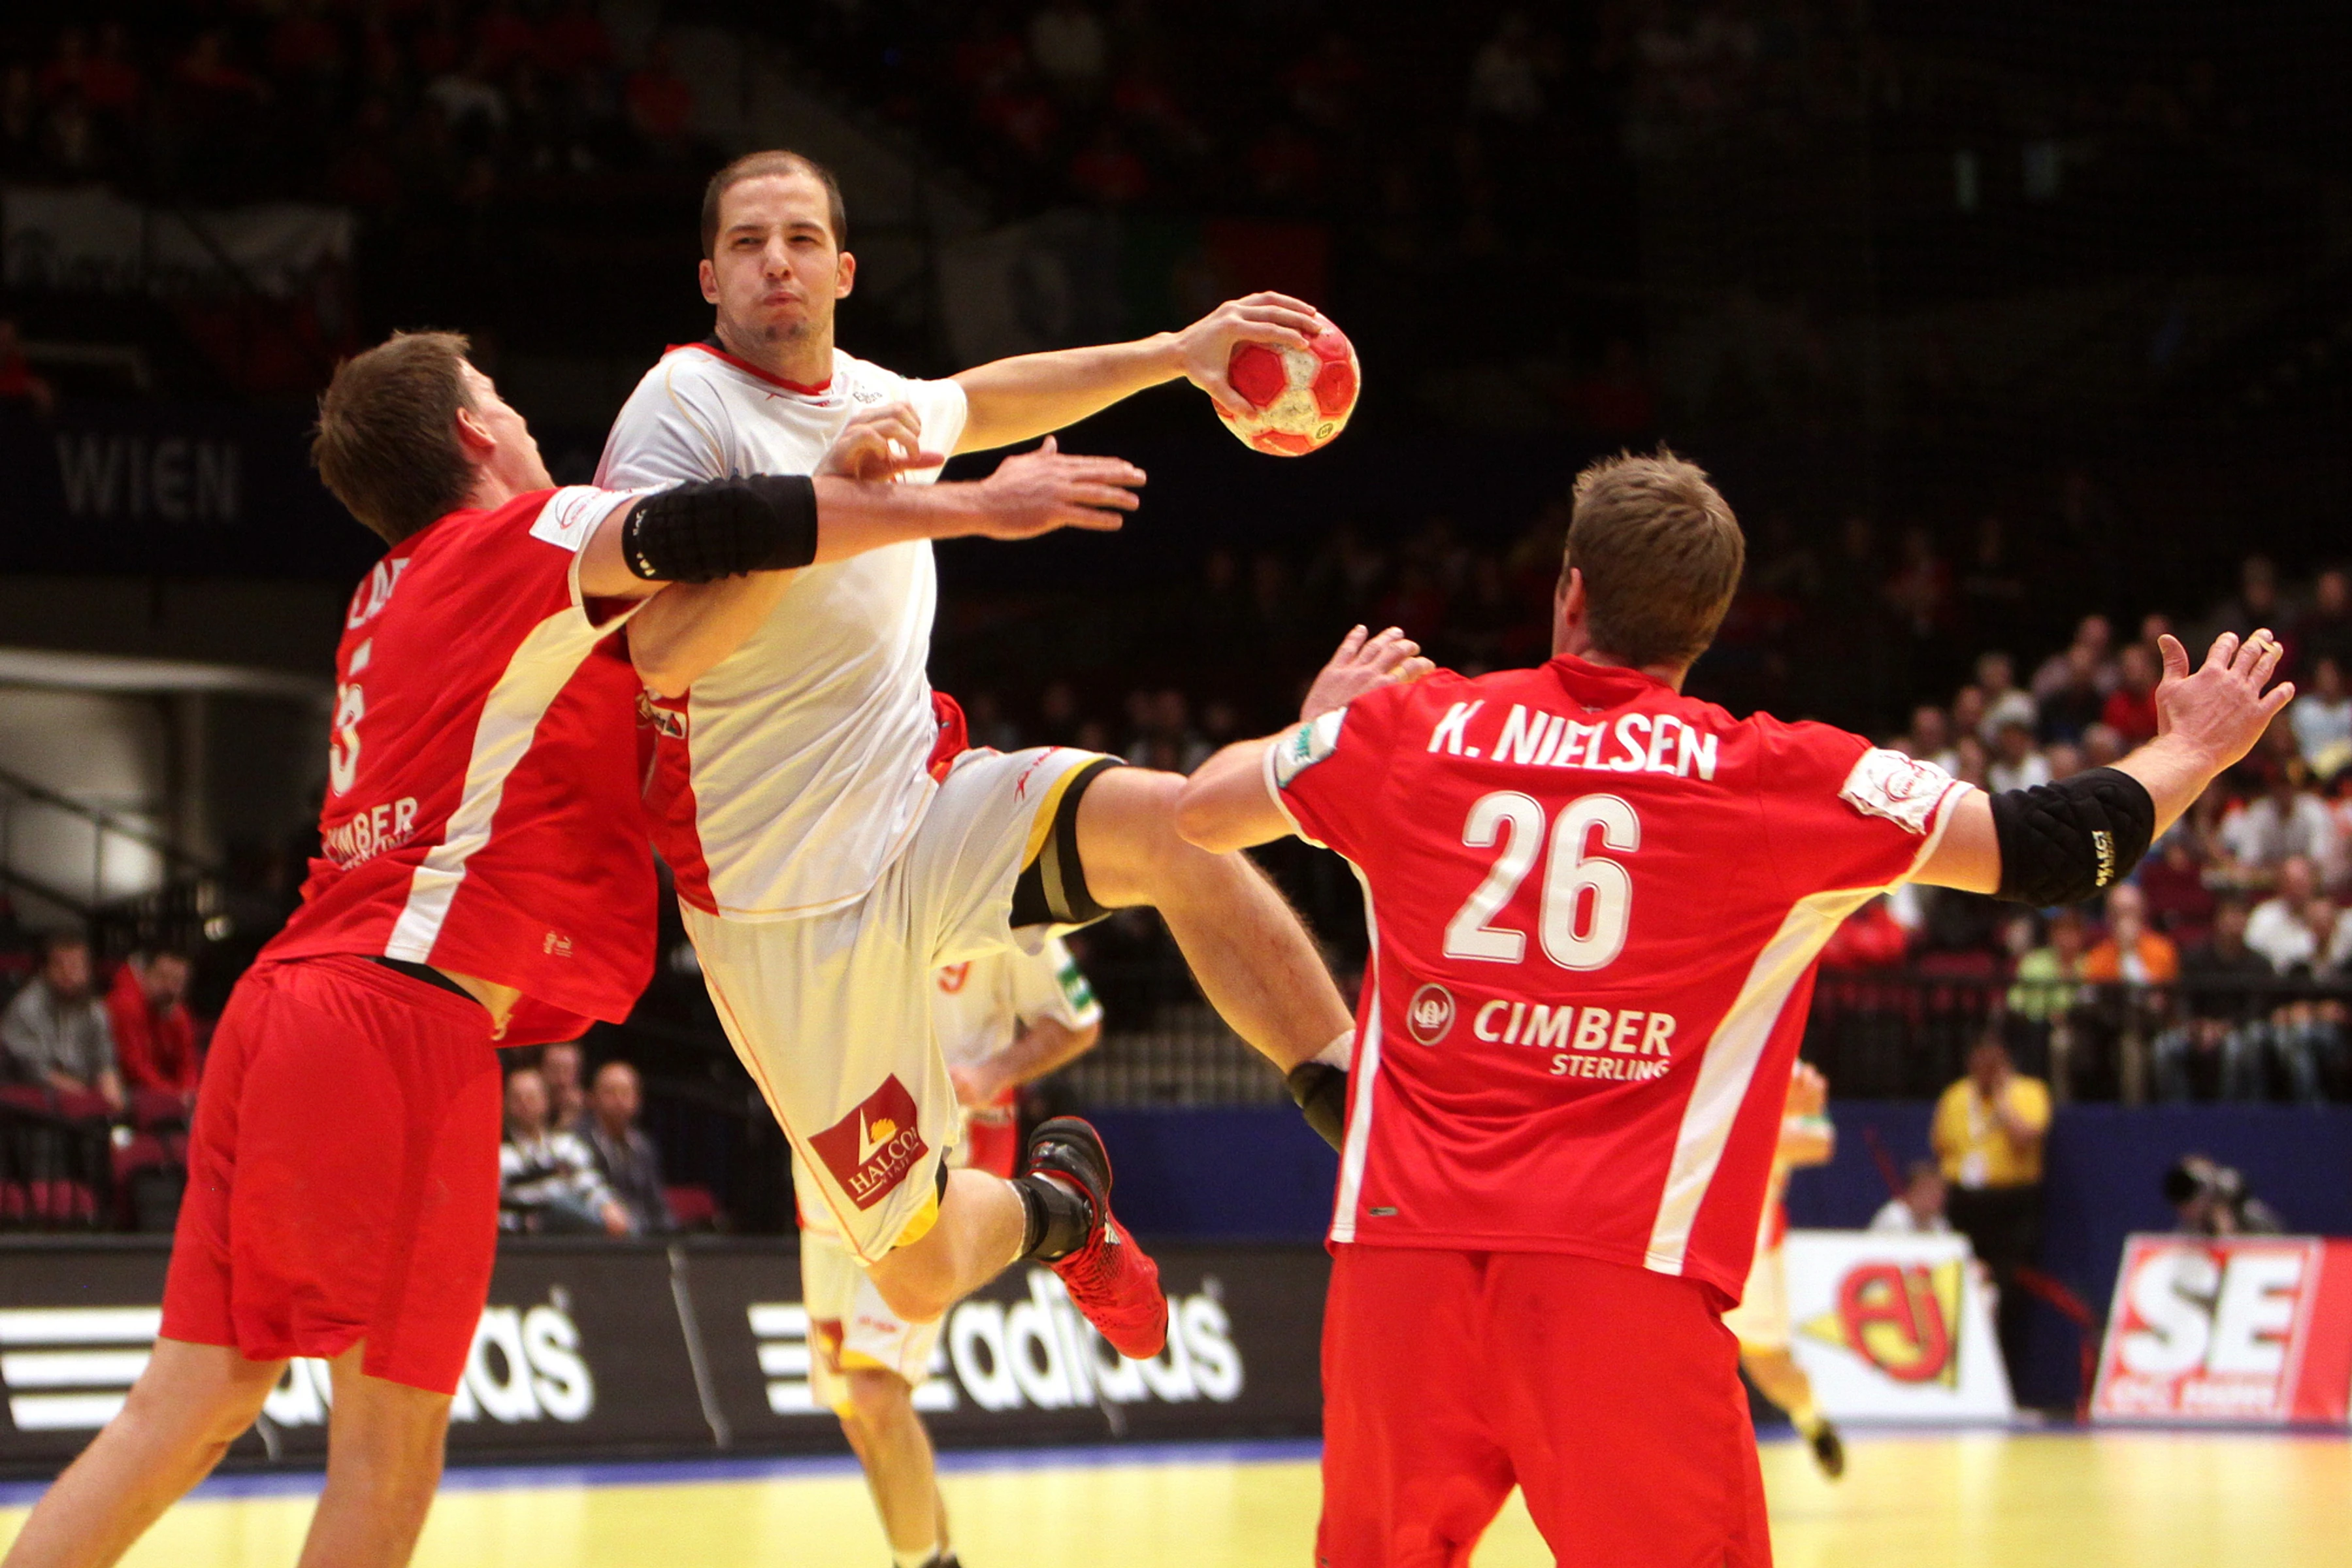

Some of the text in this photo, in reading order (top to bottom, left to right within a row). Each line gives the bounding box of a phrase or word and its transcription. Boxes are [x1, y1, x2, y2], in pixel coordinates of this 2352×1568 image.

[55, 432, 240, 521] WIEN
[1427, 699, 1718, 781] K. NIELSEN
[1442, 789, 1642, 972] 26
[1473, 999, 1677, 1056] CIMBER
[1549, 1053, 1671, 1082] STERLING
[2120, 1245, 2304, 1373] SE
